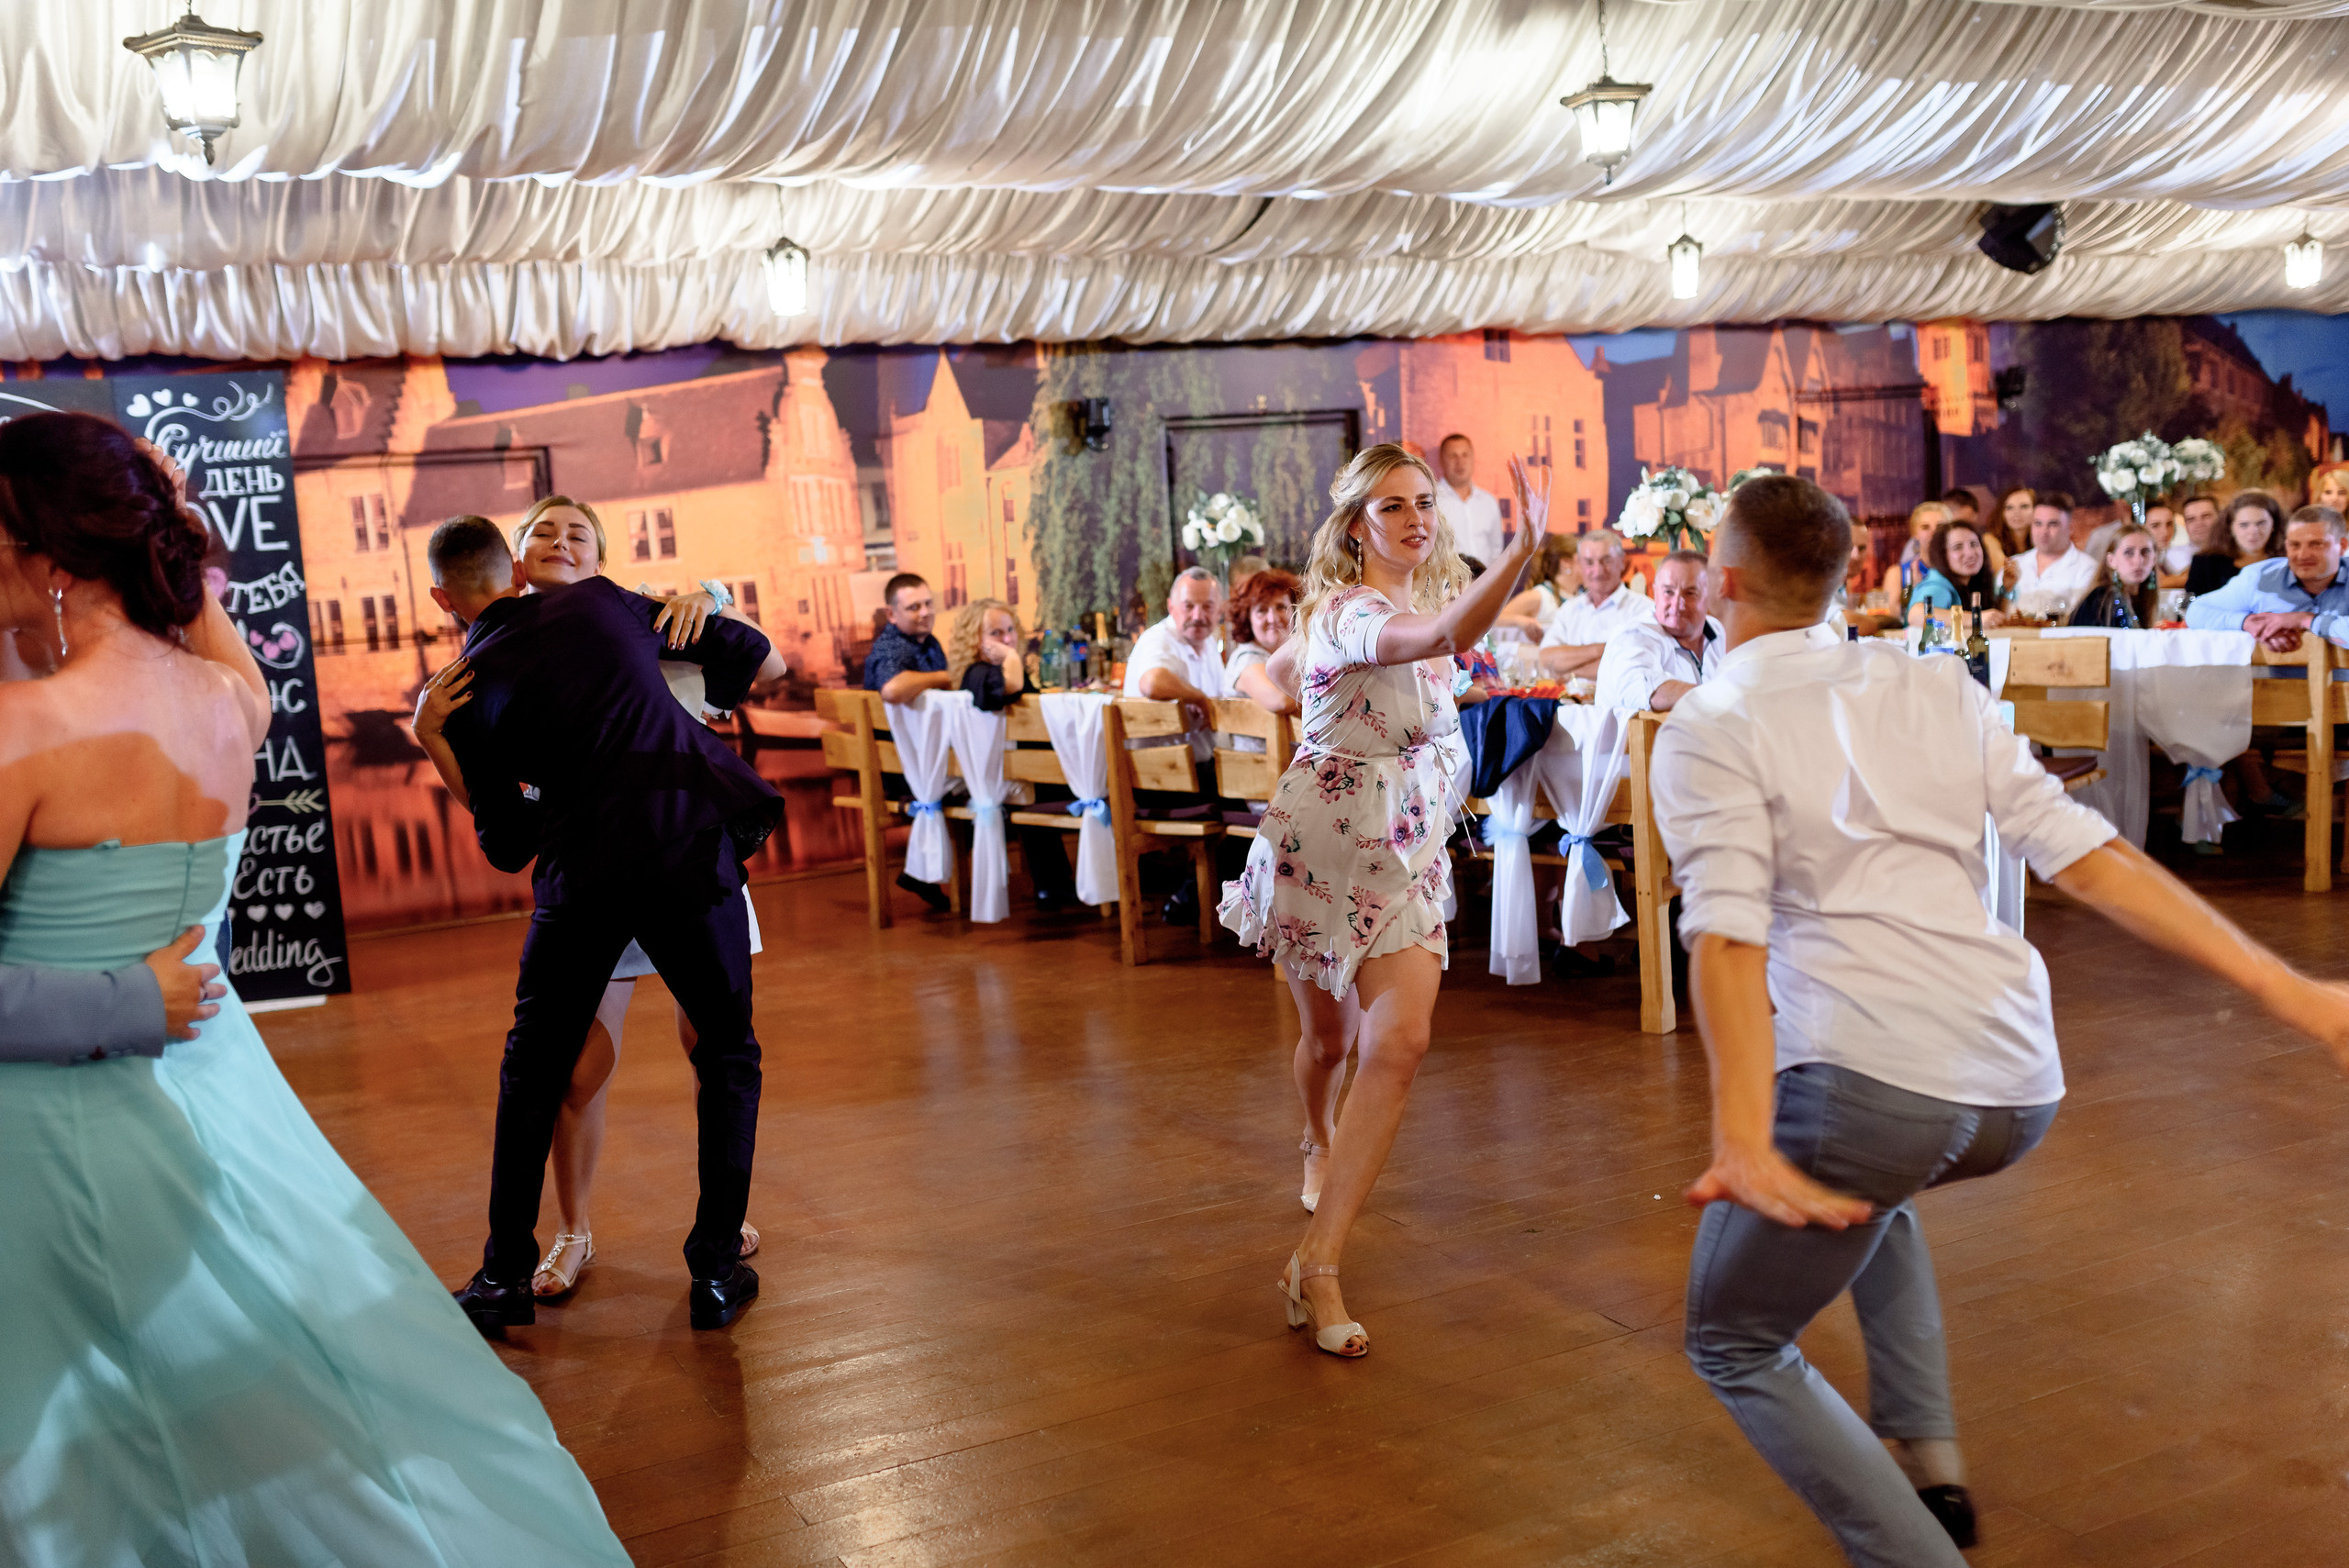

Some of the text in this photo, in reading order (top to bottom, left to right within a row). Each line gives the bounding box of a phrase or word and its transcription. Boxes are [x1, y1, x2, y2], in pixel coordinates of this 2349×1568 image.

[198, 464, 286, 501] ДЕНЬ
[225, 561, 306, 615] ТЕБЯ
[241, 817, 326, 855] стье
